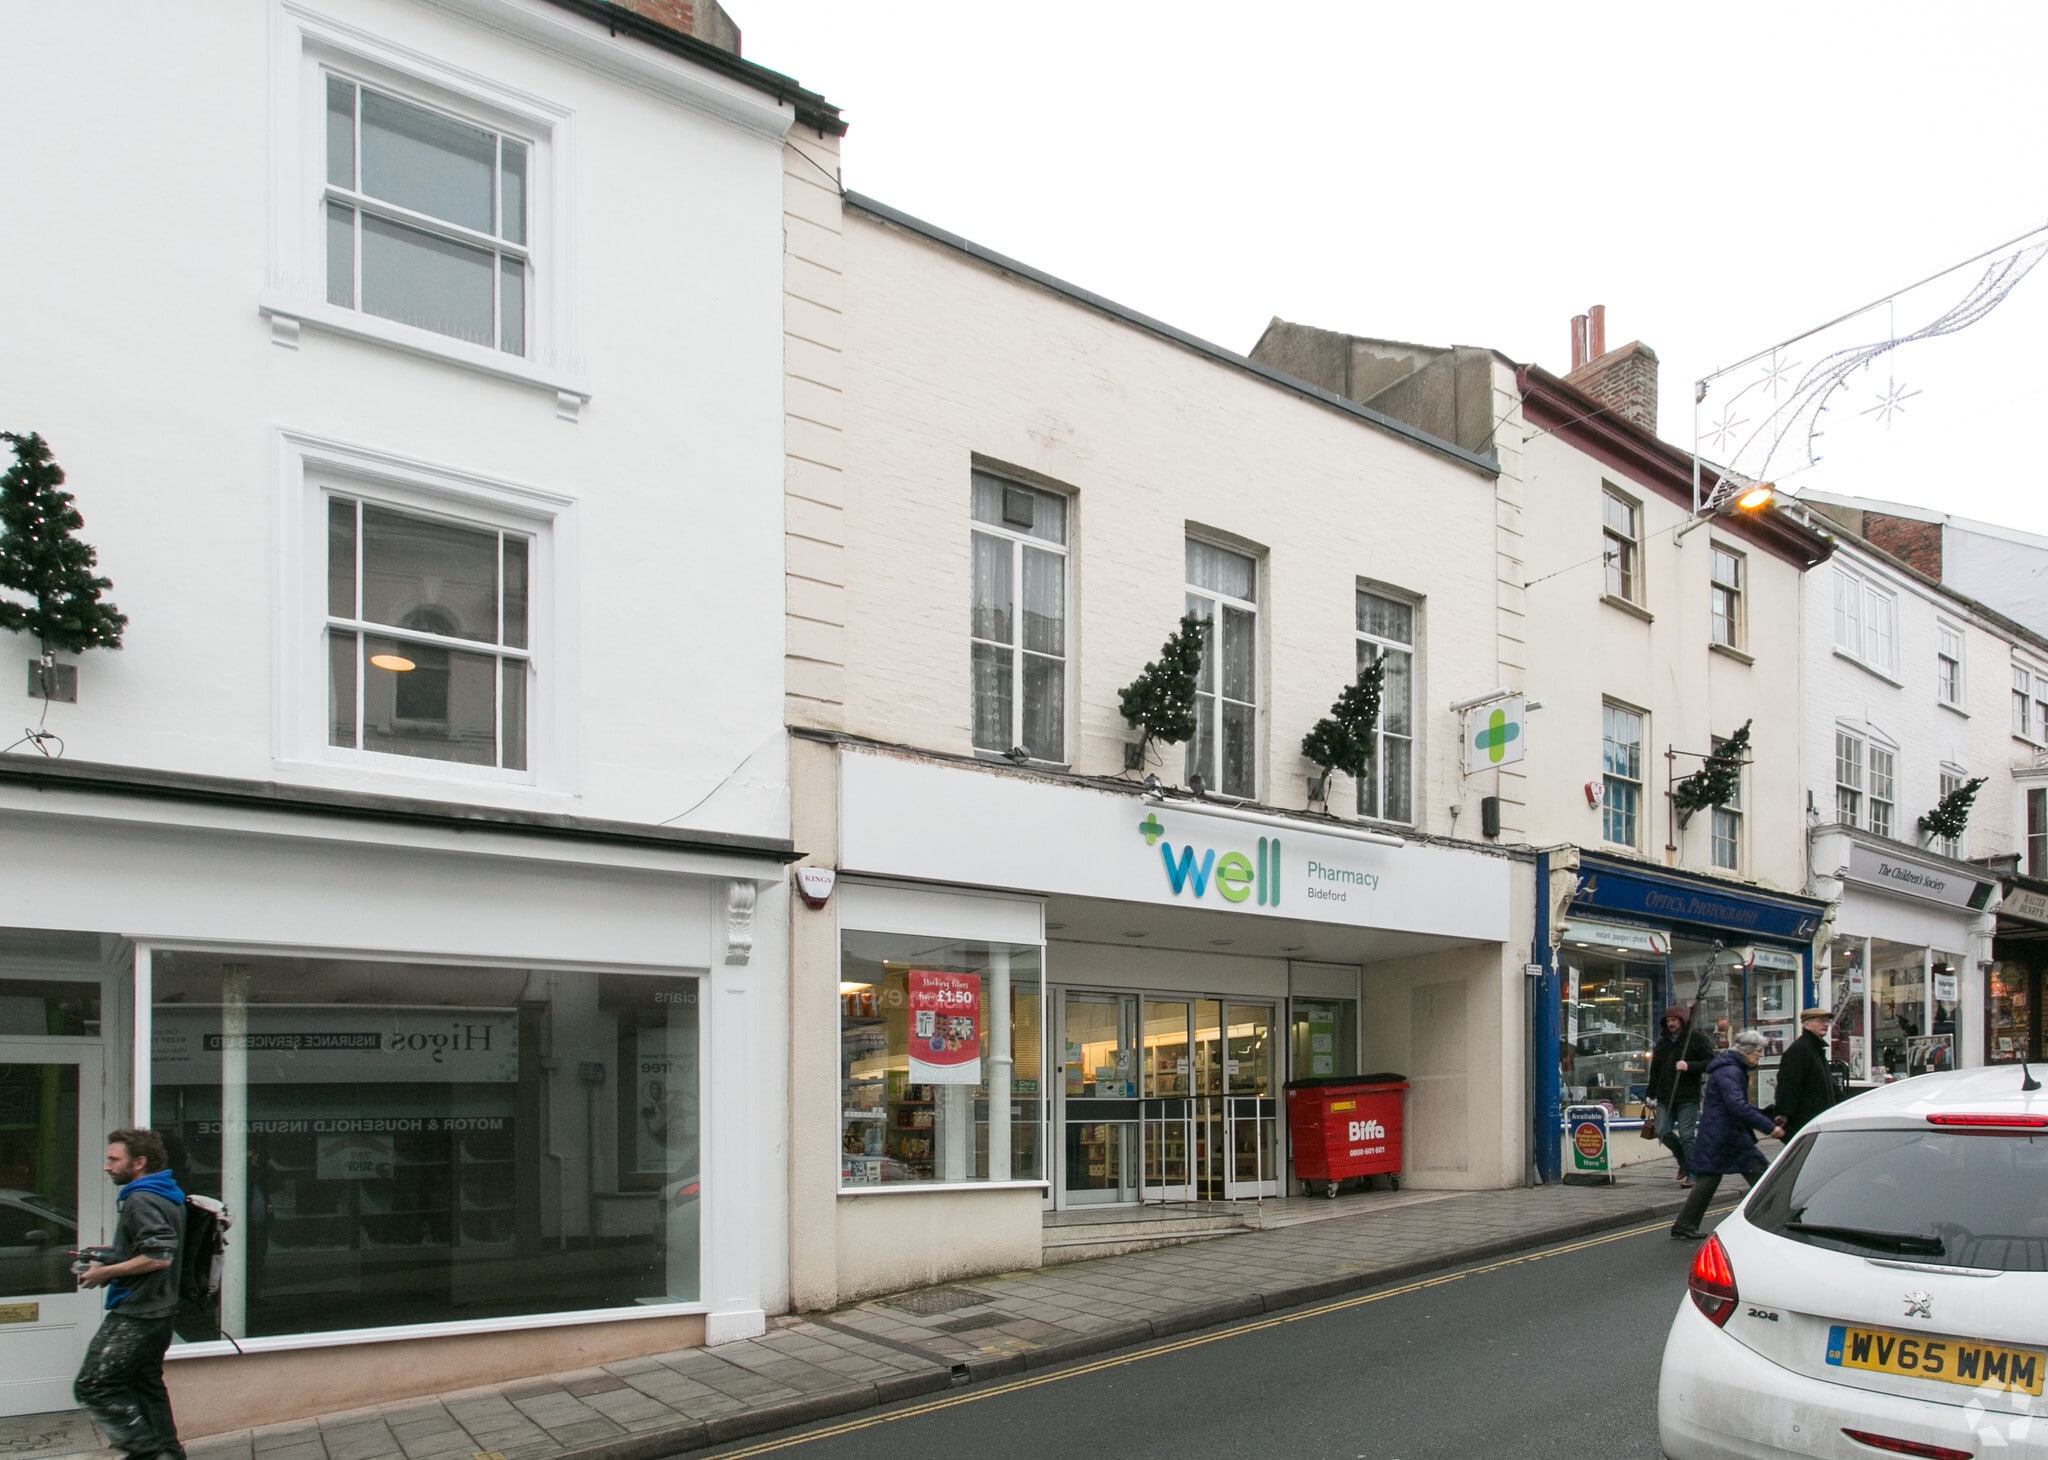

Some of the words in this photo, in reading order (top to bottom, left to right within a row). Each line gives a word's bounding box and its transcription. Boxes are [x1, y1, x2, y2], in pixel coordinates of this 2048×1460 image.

[804, 874, 832, 883] KINGS
[1161, 836, 1281, 907] well
[1308, 861, 1379, 890] Pharmacy
[1878, 864, 1892, 877] The
[1891, 867, 1923, 887] Children's
[1923, 876, 1946, 894] Society
[1308, 887, 1346, 902] Bideford
[937, 990, 972, 1003] £1.50
[1348, 1119, 1385, 1142] Biffa
[1747, 1308, 1779, 1322] 208
[1828, 1350, 1841, 1359] GB
[1851, 1332, 1946, 1373] WV65
[1957, 1346, 2036, 1388] WMM
